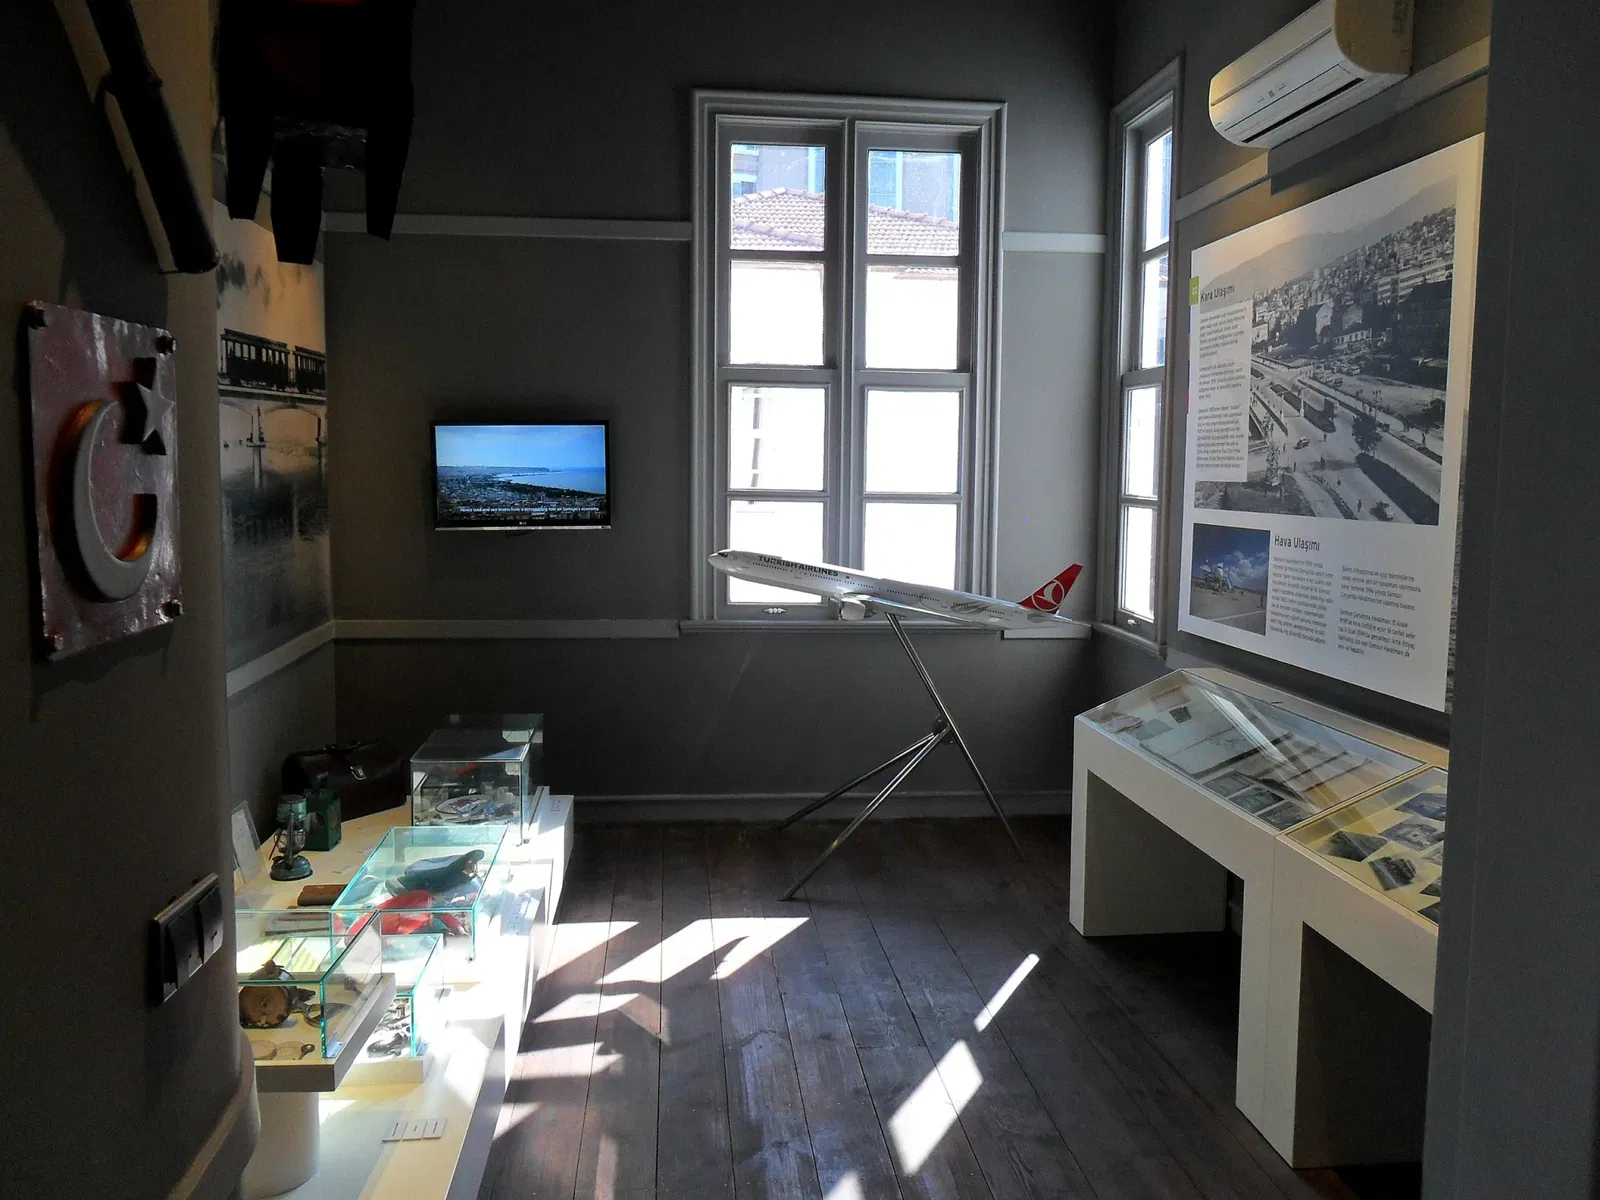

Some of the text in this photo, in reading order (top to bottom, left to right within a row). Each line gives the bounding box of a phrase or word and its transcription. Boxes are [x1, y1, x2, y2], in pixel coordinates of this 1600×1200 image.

[1200, 285, 1235, 303] Kara Ulaşımı
[1274, 535, 1320, 552] Hava Ulaşımı
[758, 555, 839, 577] TURKISH AIRLINES
